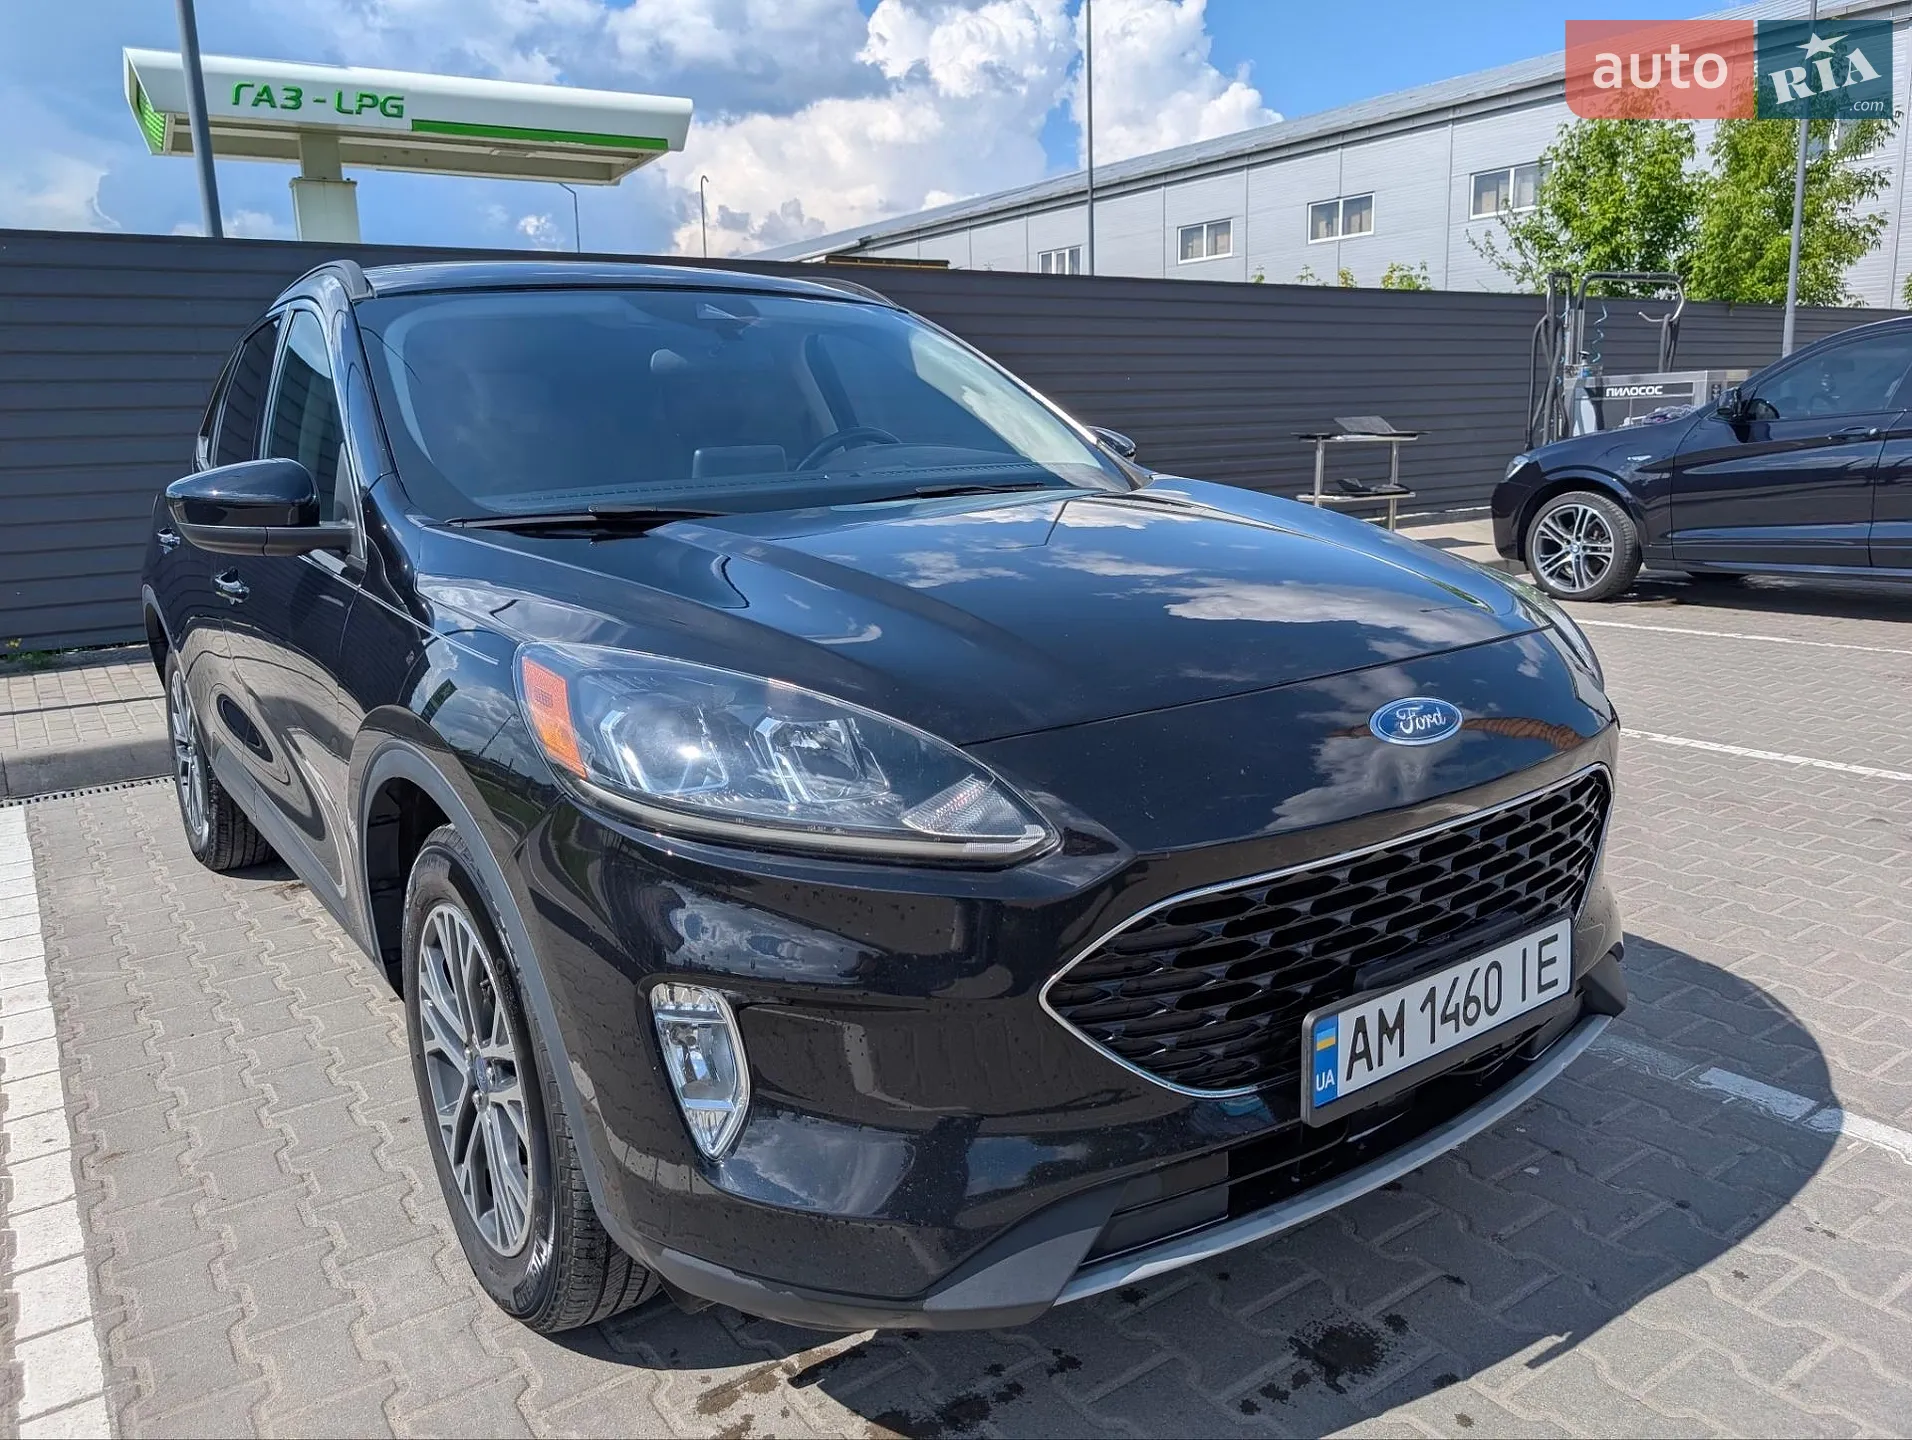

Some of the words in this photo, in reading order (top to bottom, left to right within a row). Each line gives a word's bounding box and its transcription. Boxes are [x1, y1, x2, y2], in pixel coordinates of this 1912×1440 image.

[232, 81, 304, 110] ГАЗ
[335, 88, 405, 118] LPG
[1605, 385, 1664, 397] ПИЛОСОС
[1396, 704, 1446, 734] Ford
[1346, 998, 1406, 1082] AM
[1419, 960, 1503, 1044] 1460
[1521, 933, 1559, 1003] IE
[1316, 1069, 1335, 1091] UA
